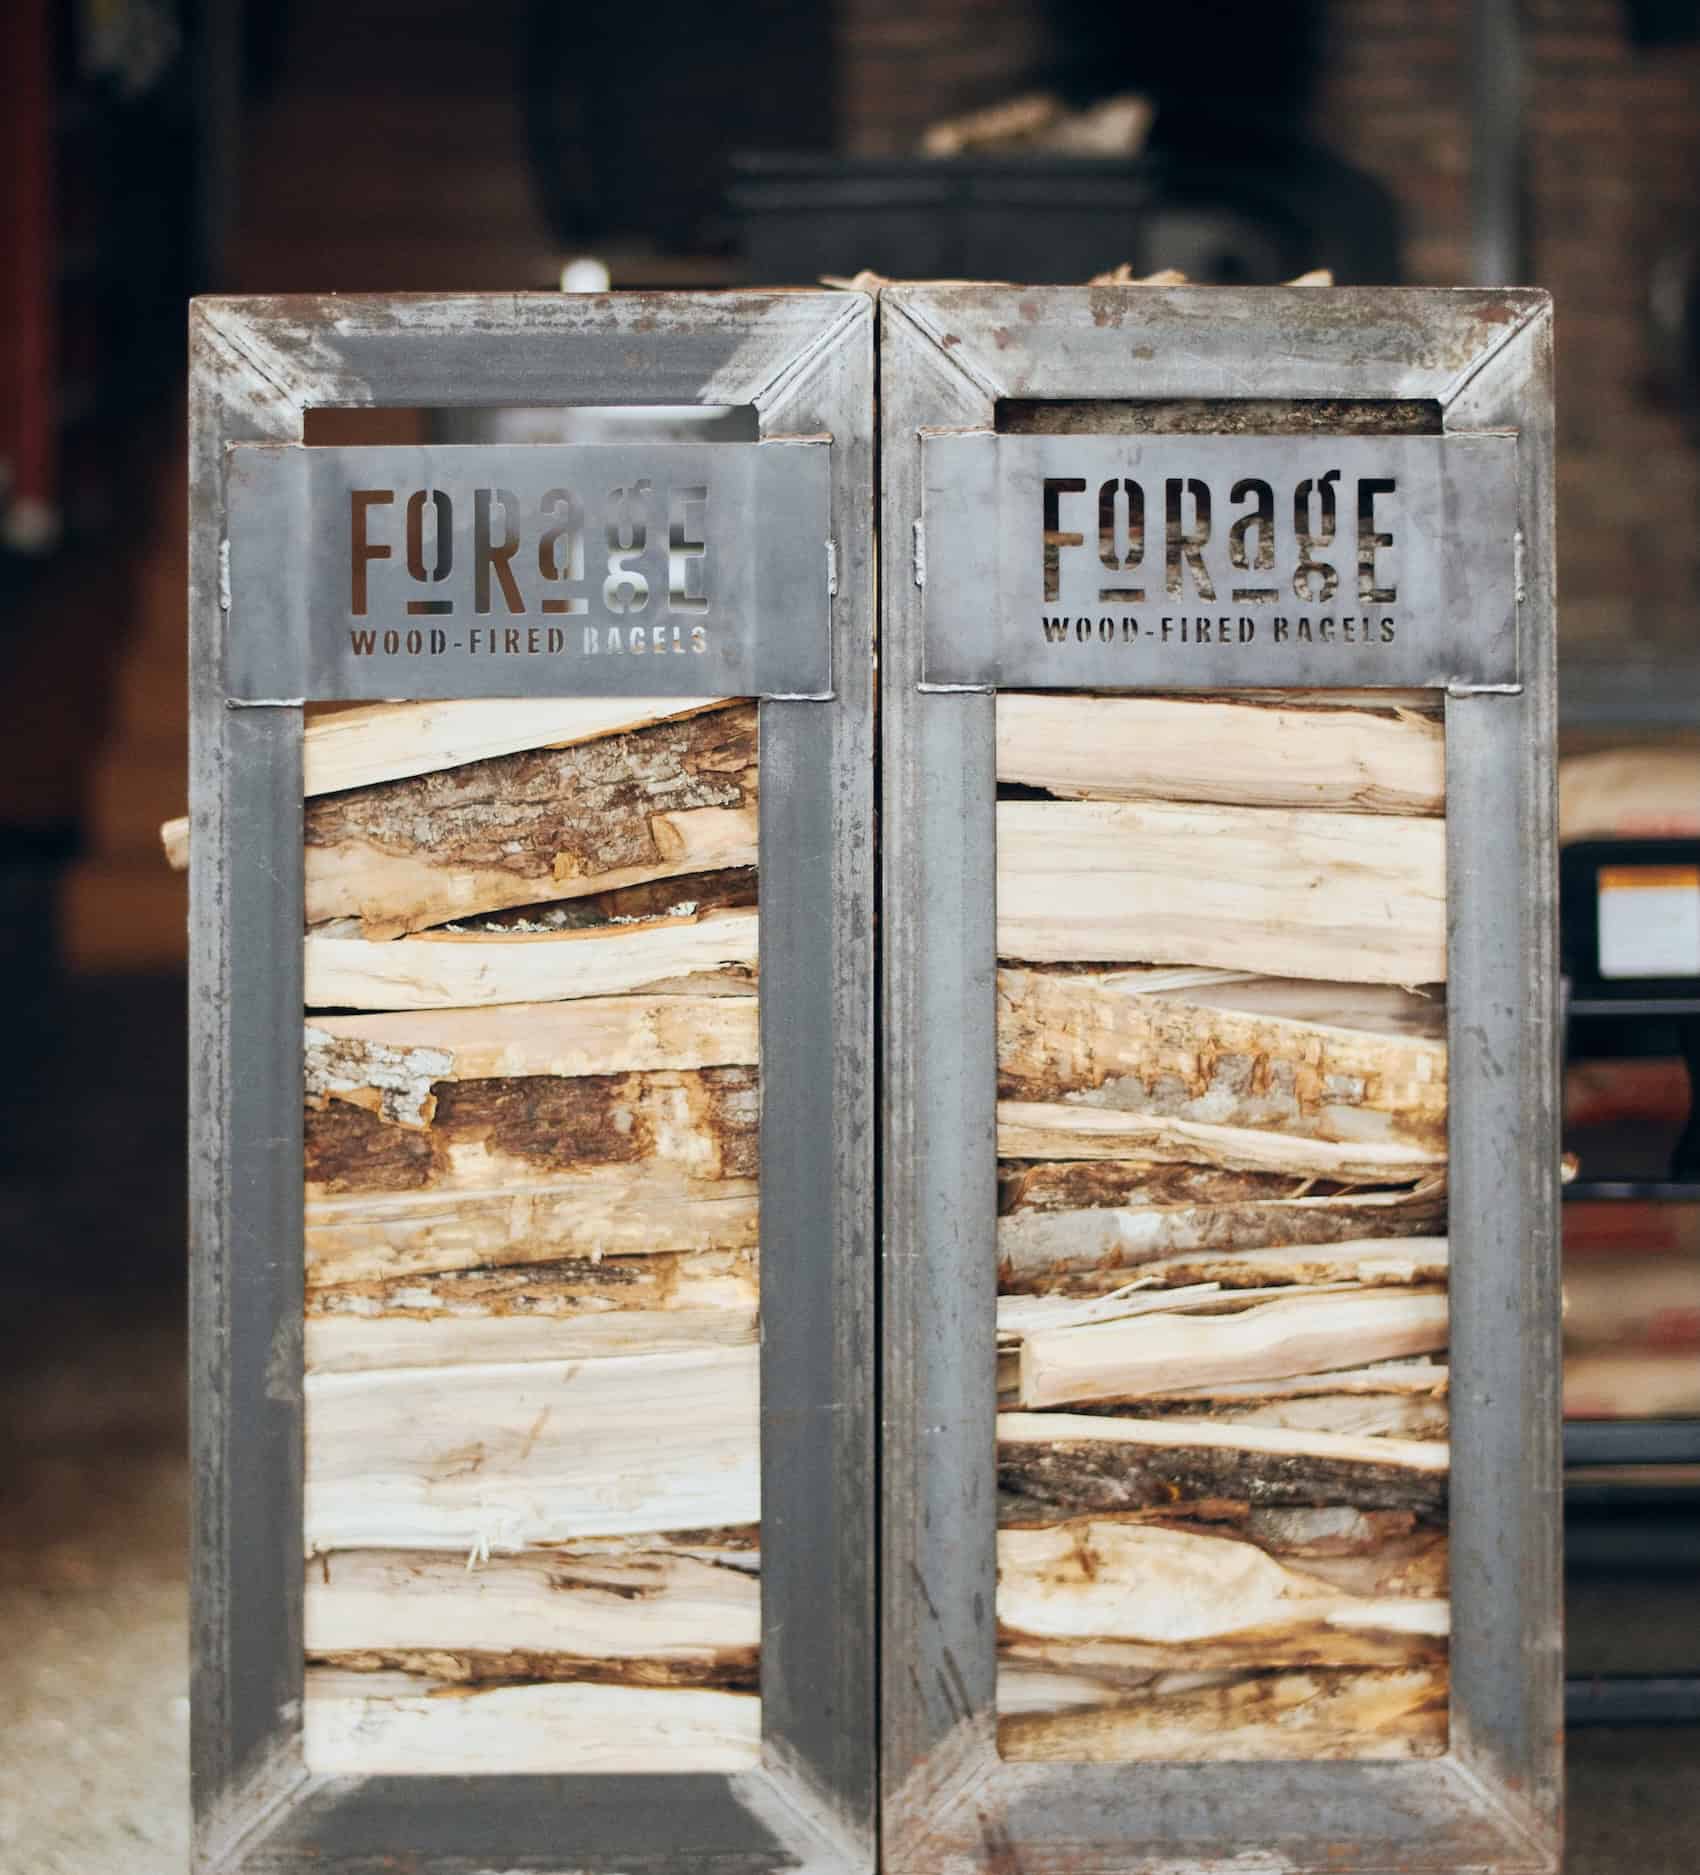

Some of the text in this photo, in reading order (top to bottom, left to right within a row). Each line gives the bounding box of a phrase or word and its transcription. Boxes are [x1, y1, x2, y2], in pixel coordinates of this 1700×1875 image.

[349, 625, 708, 656] WOOD-FIRED BAGELS
[1041, 616, 1397, 644] WOOD-FIRED BAGELS
